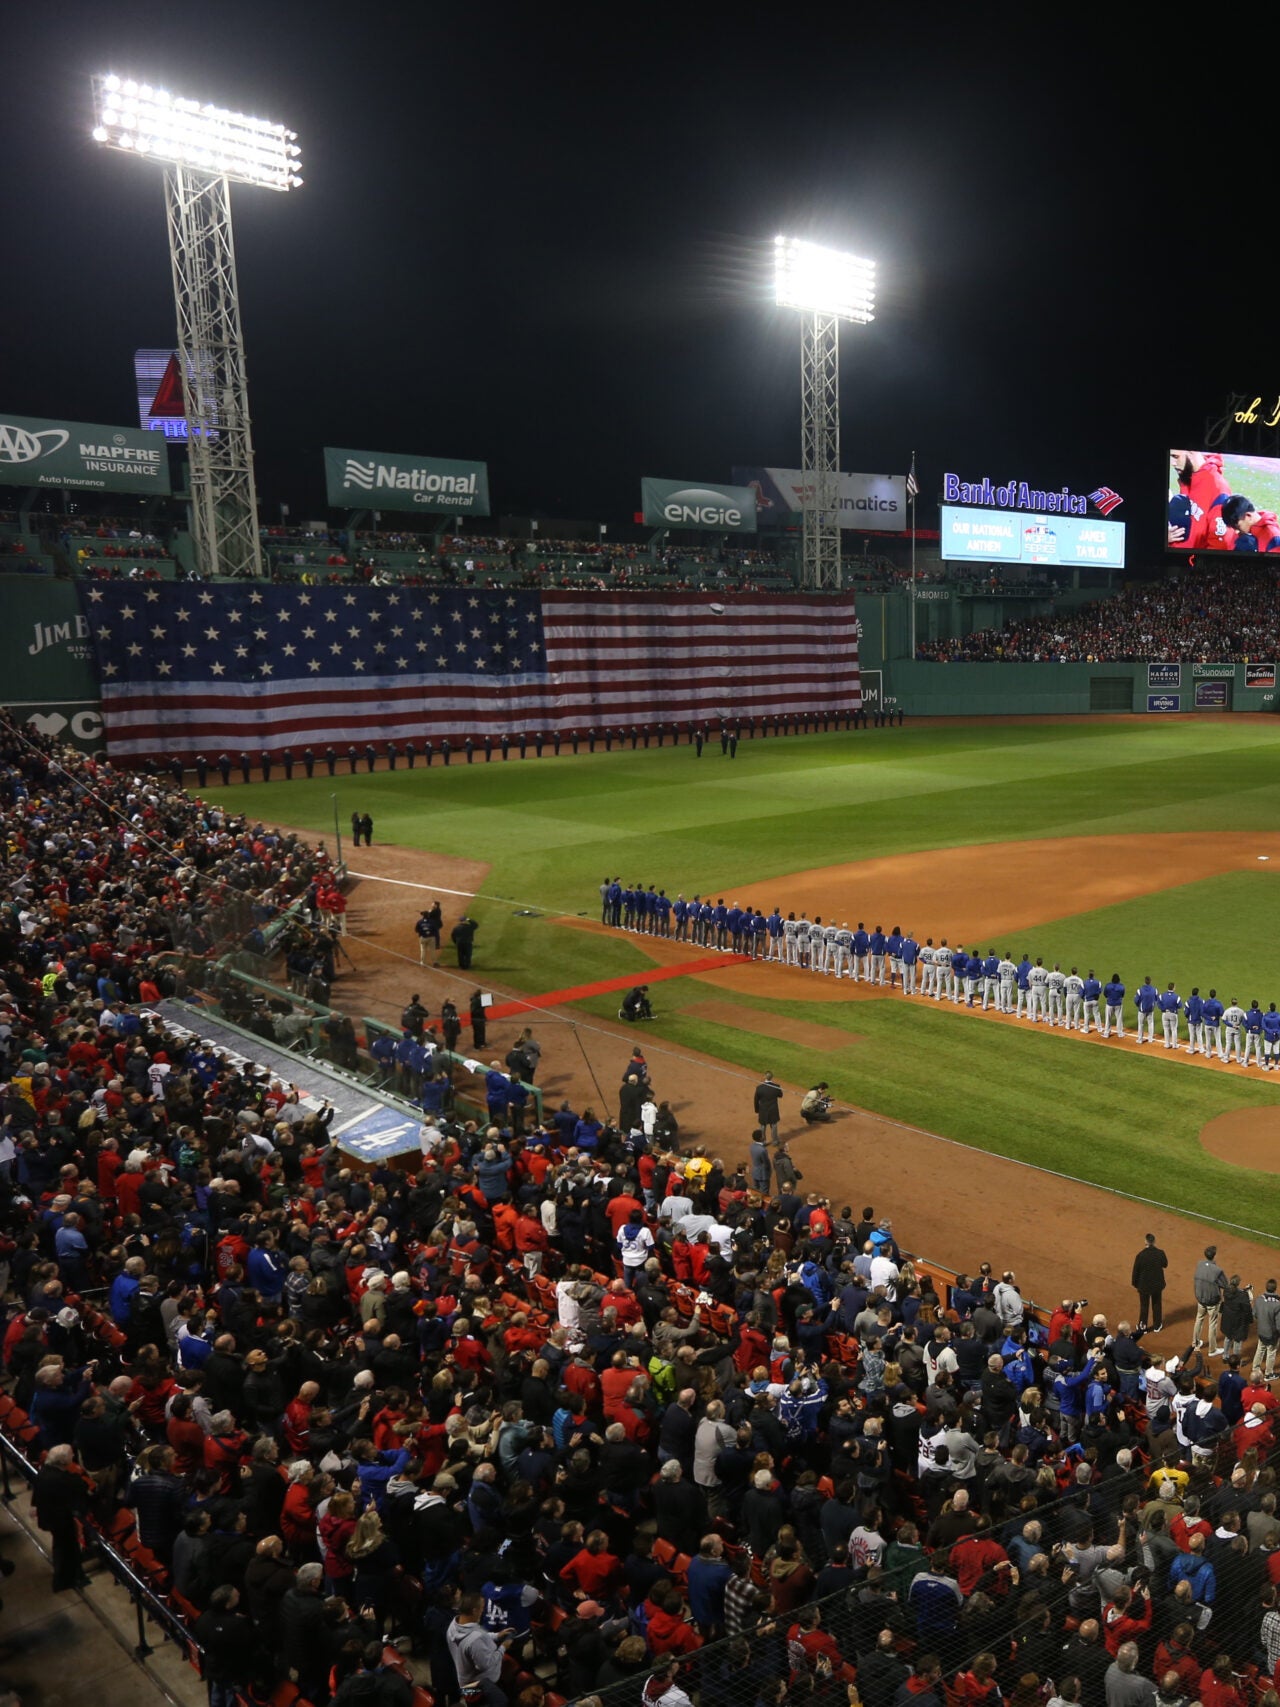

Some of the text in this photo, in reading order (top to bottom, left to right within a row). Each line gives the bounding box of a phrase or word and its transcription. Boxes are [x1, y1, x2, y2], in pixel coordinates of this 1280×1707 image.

[79, 443, 161, 462] MAPFRE
[86, 460, 158, 477] INSURANCE
[38, 474, 105, 488] Auto Insurance
[376, 465, 477, 494] National
[413, 492, 473, 506] Car Rental
[944, 473, 1087, 515] Bank of America
[485, 1598, 508, 1625] LA
